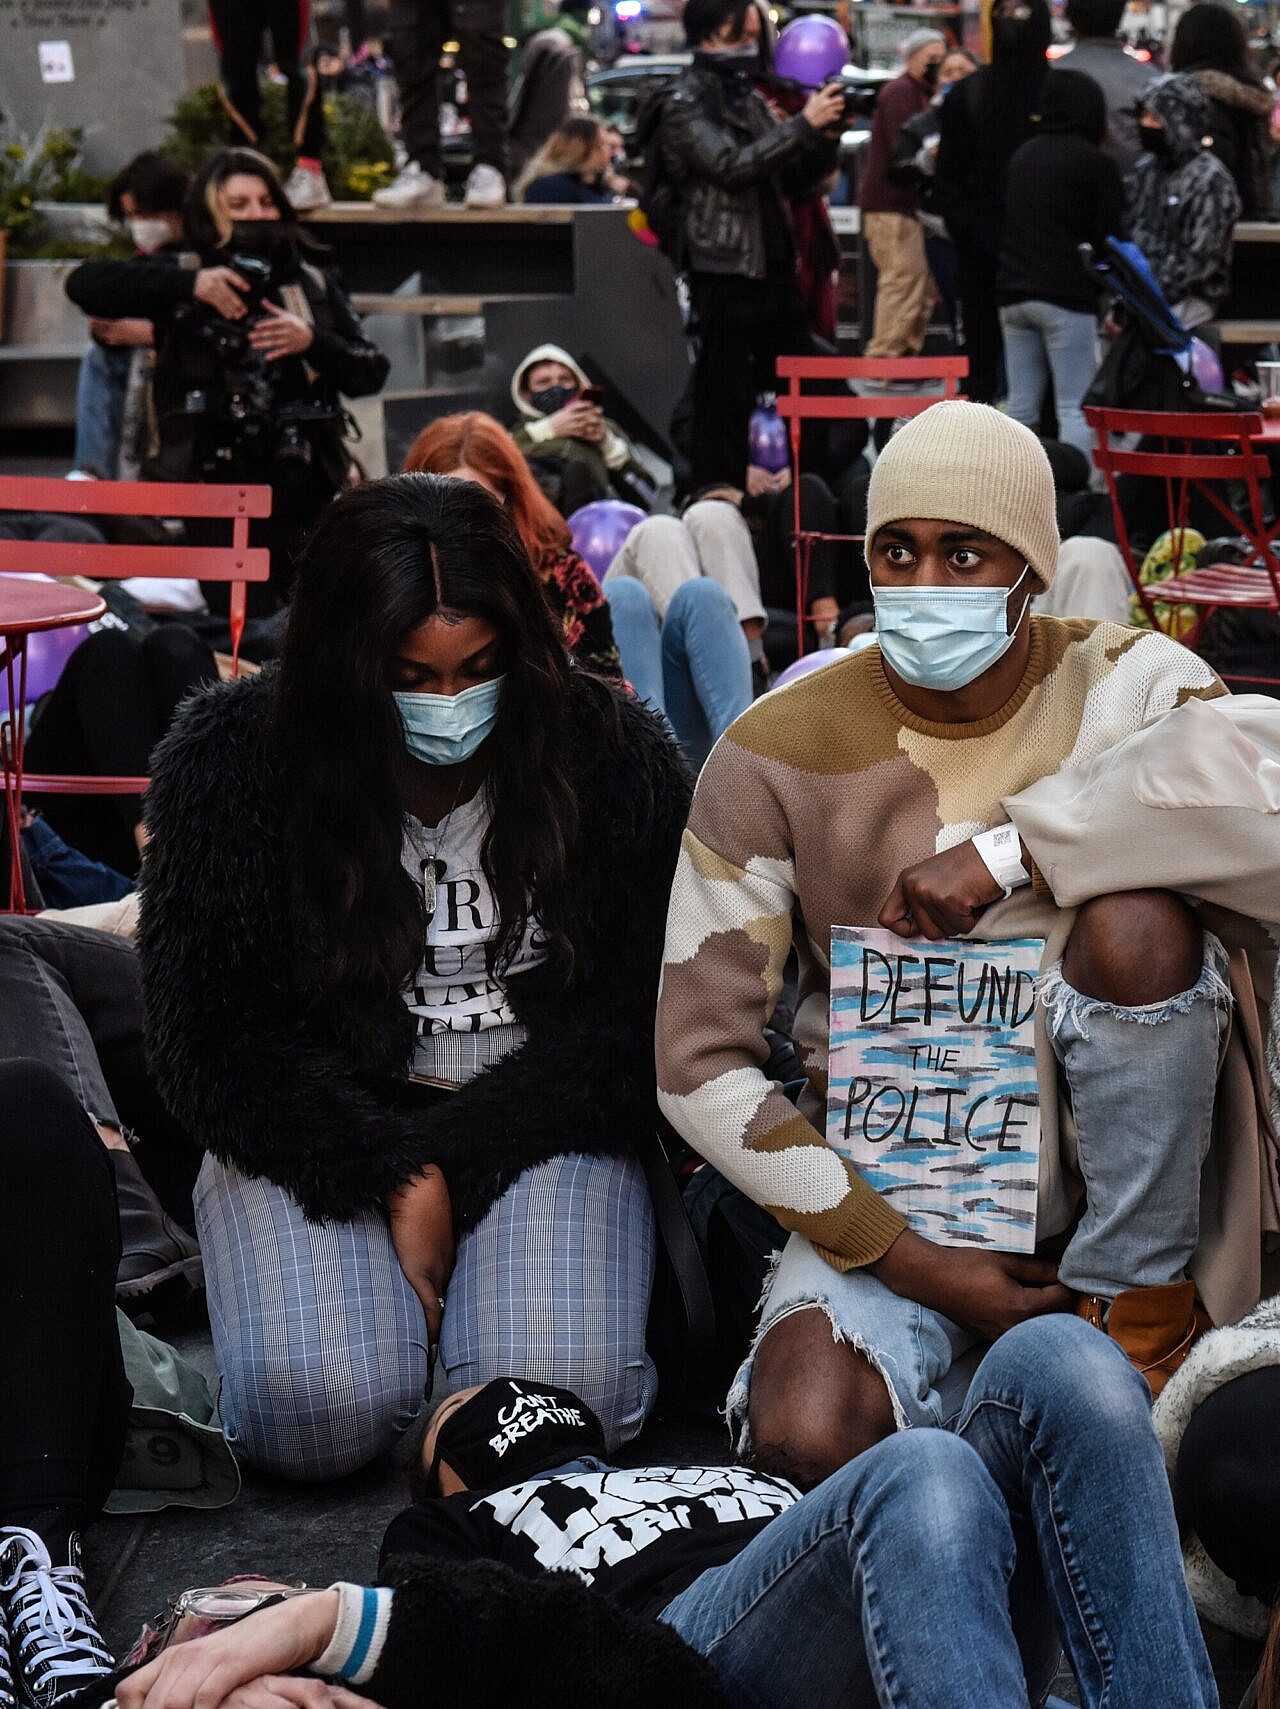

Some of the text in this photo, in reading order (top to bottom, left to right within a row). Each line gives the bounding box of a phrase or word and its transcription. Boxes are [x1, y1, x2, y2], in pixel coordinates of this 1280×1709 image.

[860, 948, 1036, 1029] DEFUND
[908, 1044, 960, 1072] THE
[843, 1076, 1037, 1152] POLICE
[508, 1381, 523, 1395] I
[488, 1407, 587, 1458] BREATHE
